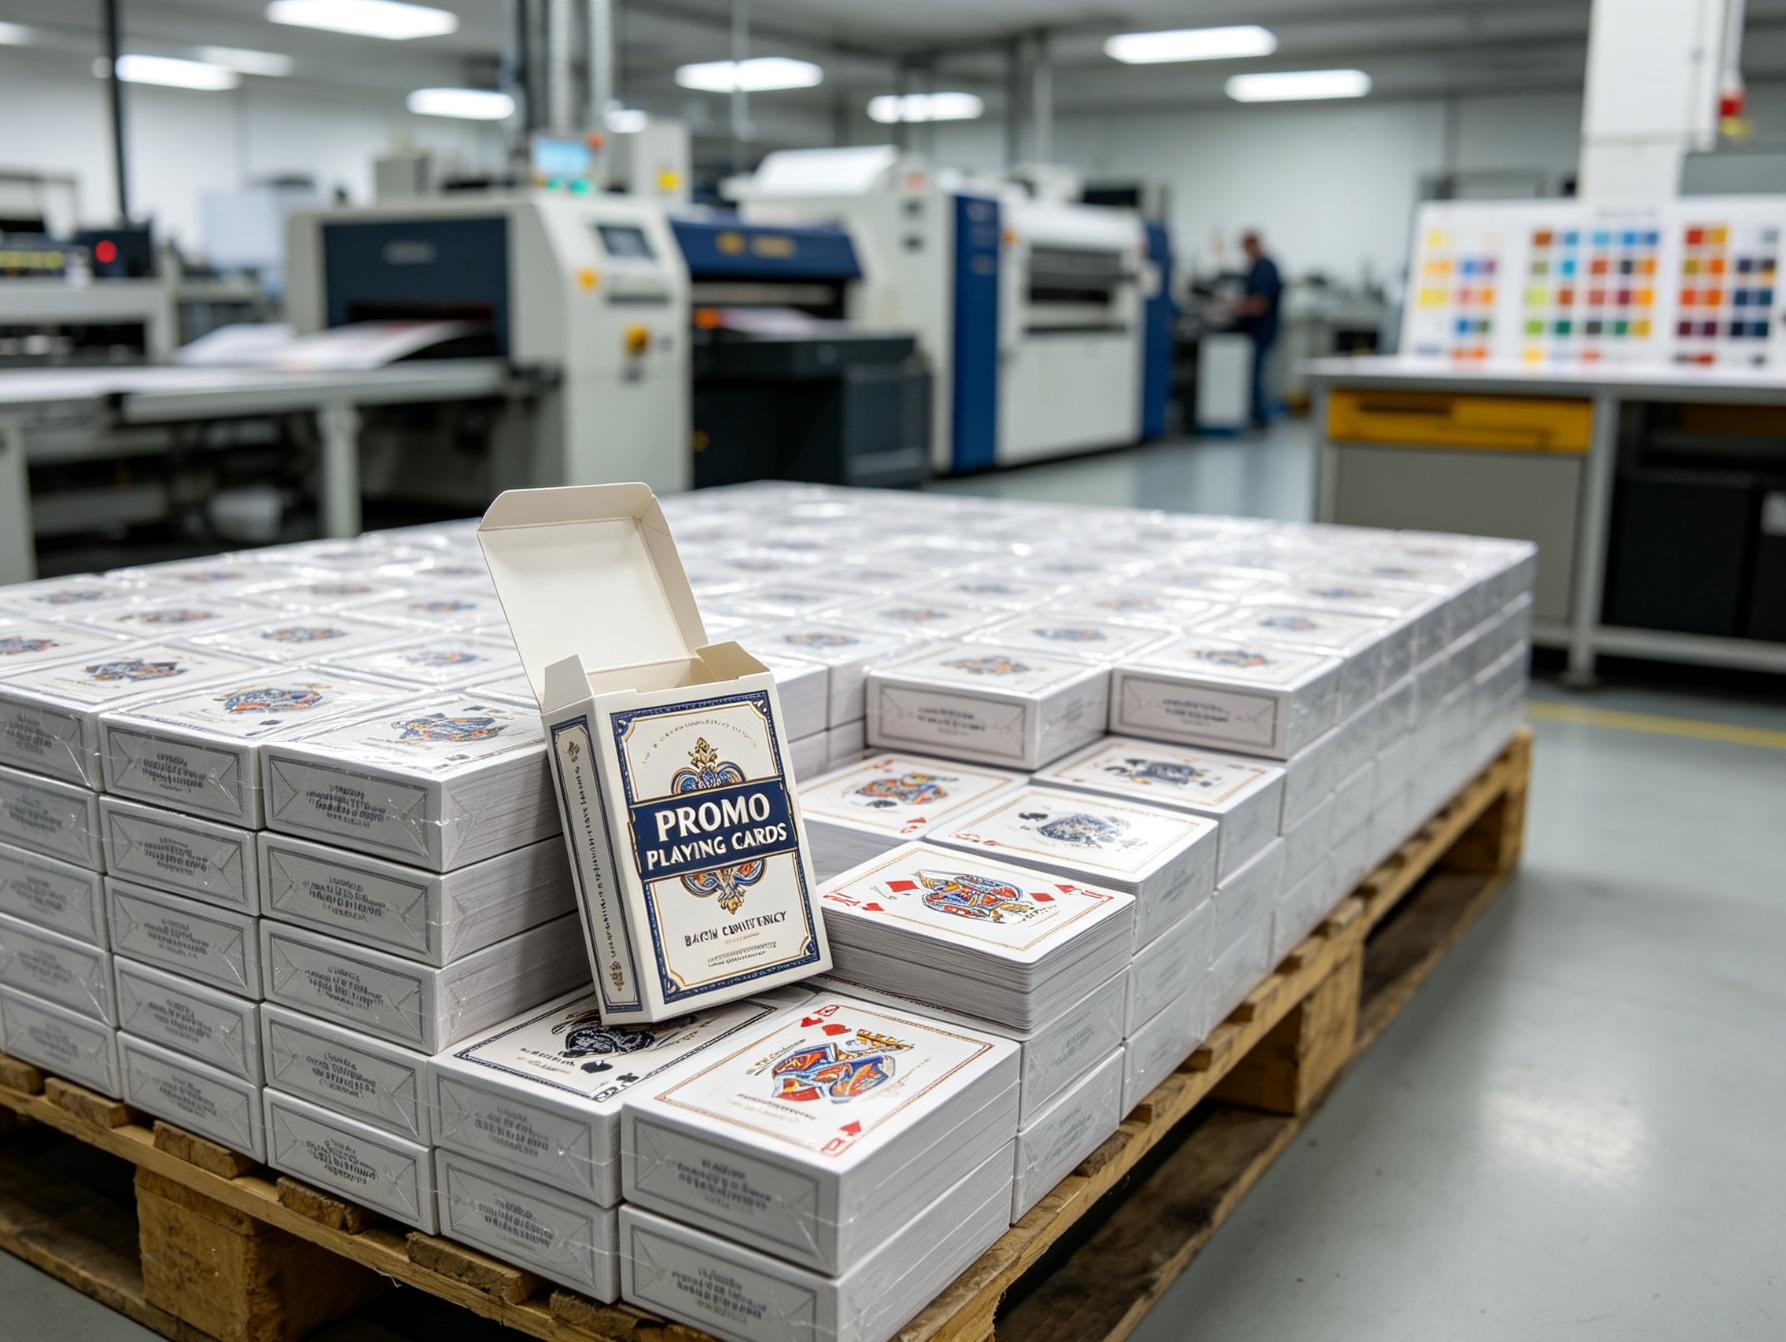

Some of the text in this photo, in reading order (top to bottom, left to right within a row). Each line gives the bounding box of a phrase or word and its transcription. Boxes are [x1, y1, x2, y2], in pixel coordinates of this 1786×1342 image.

[655, 793, 770, 842] PROMO
[646, 822, 787, 870] PLAYING CARDS
